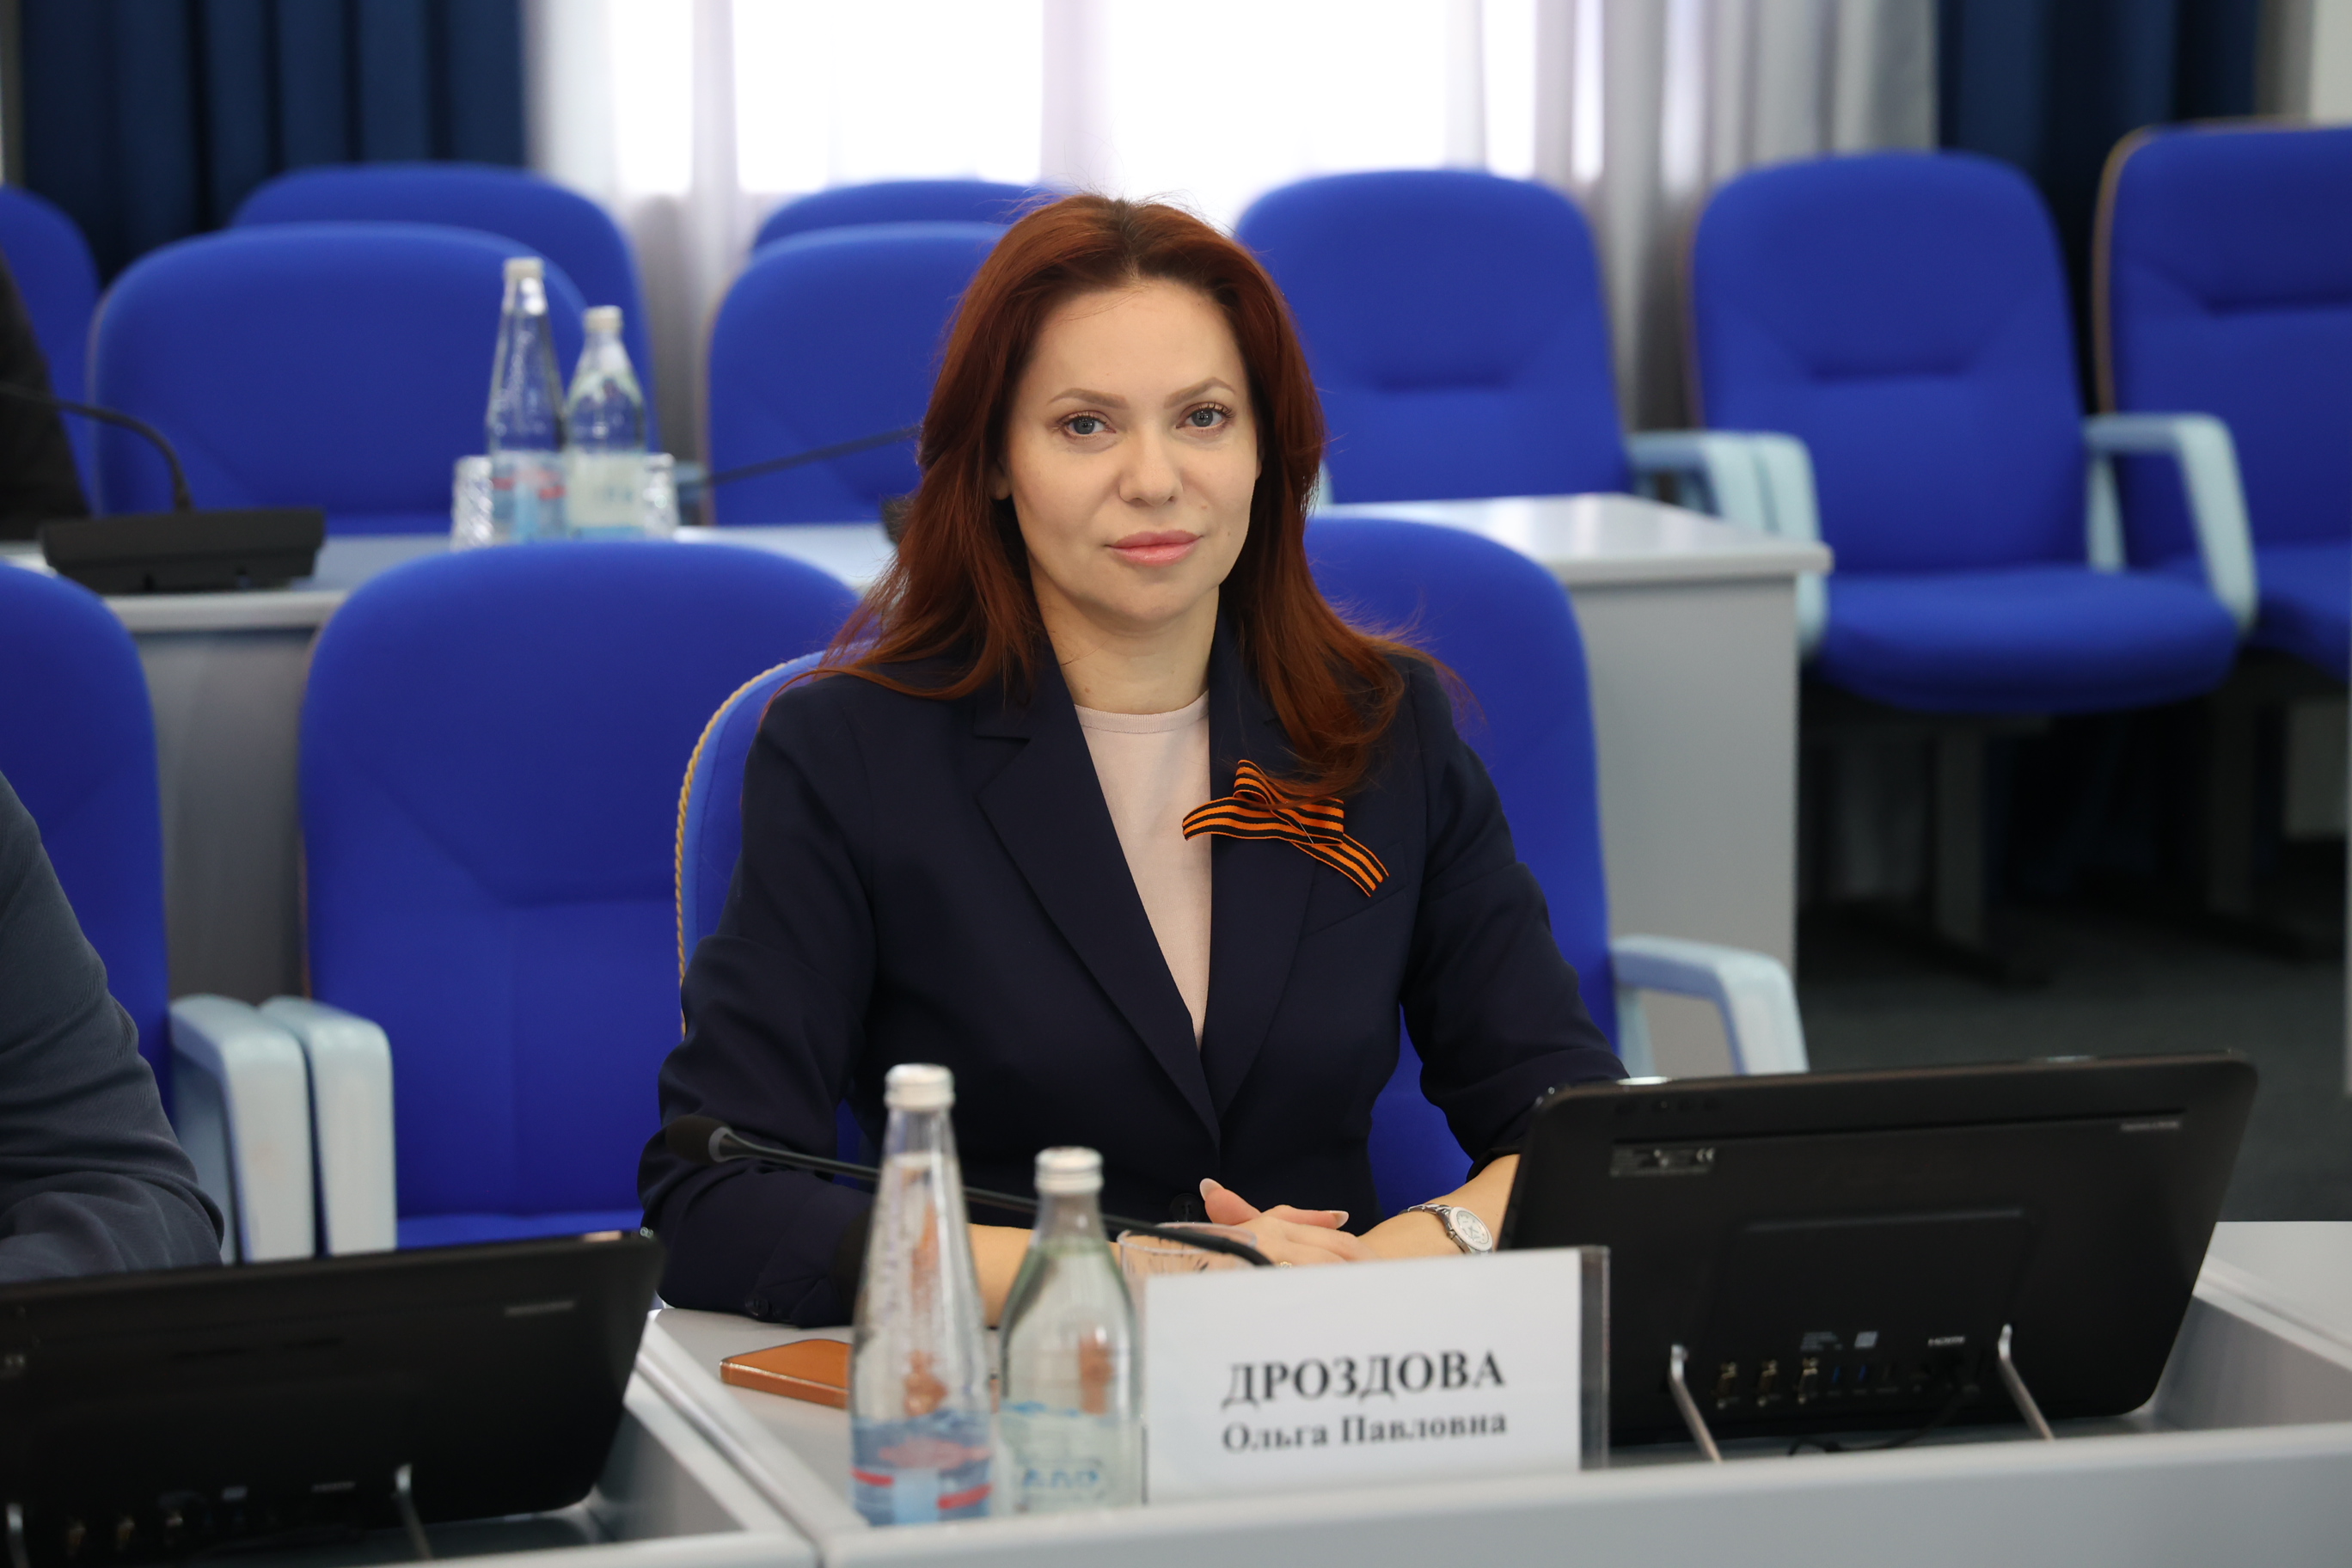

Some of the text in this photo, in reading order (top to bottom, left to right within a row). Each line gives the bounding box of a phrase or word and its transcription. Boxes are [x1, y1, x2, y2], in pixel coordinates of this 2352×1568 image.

[1222, 1349, 1505, 1409] ДРОЗДОВА
[1222, 1413, 1506, 1454] Ольга Павловна
